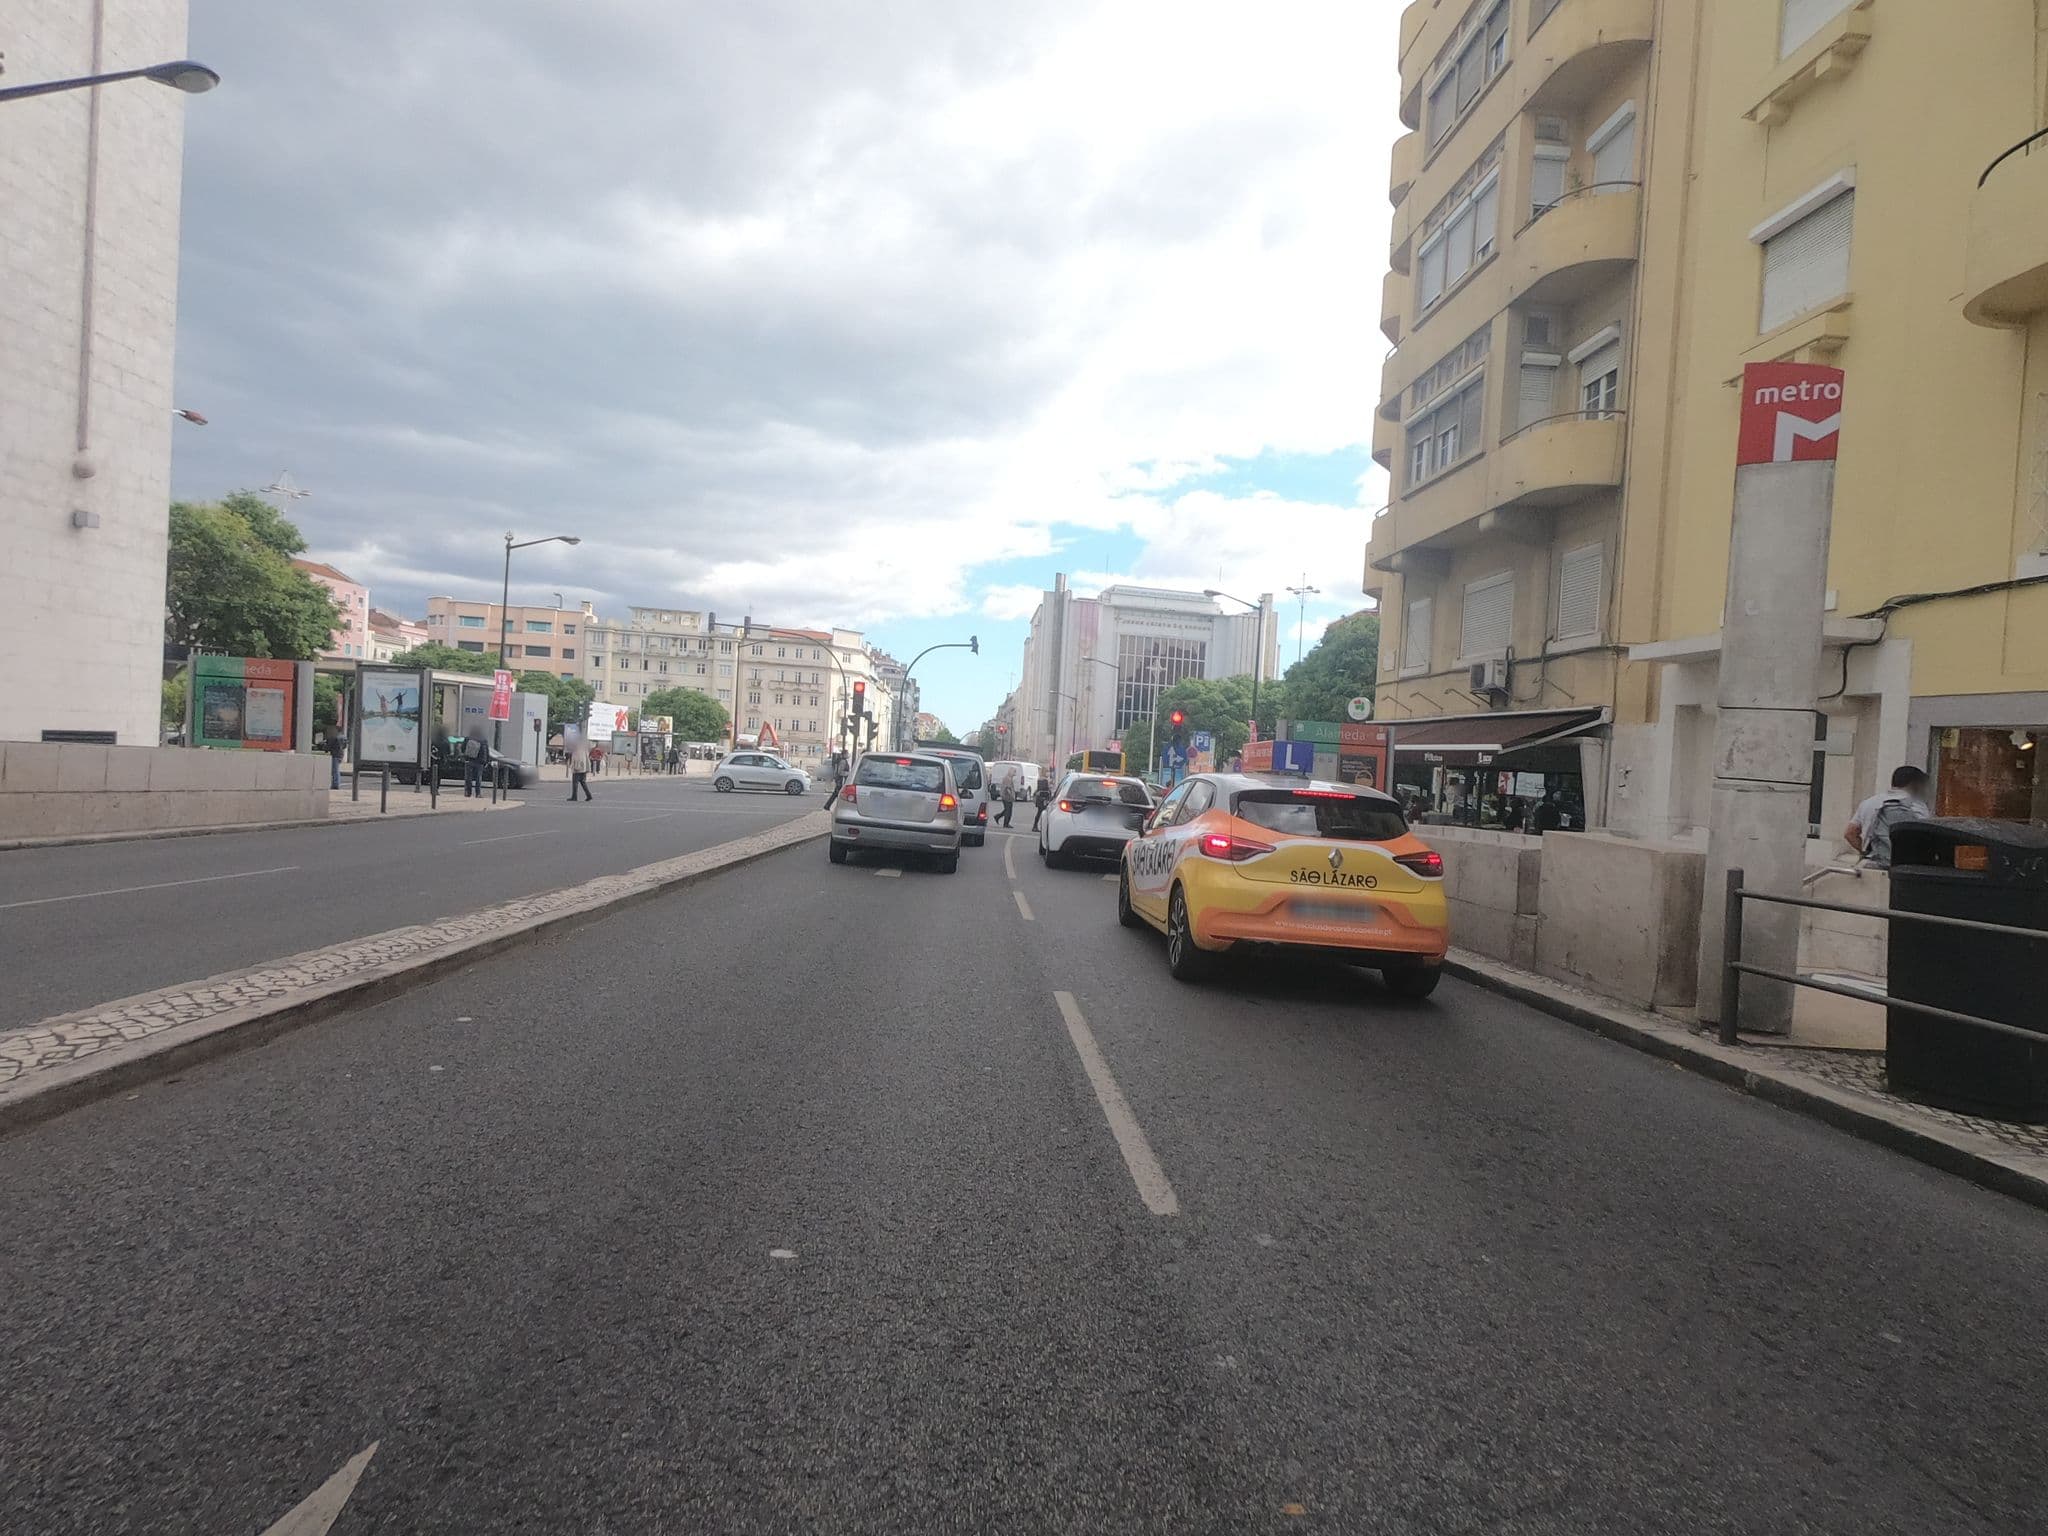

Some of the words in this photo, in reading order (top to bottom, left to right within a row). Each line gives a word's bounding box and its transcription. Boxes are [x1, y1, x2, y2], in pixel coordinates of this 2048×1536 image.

[1754, 380, 1841, 405] metro
[1285, 743, 1300, 770] L
[1290, 867, 1320, 884] SÃO
[1323, 869, 1378, 888] LÁZARO
